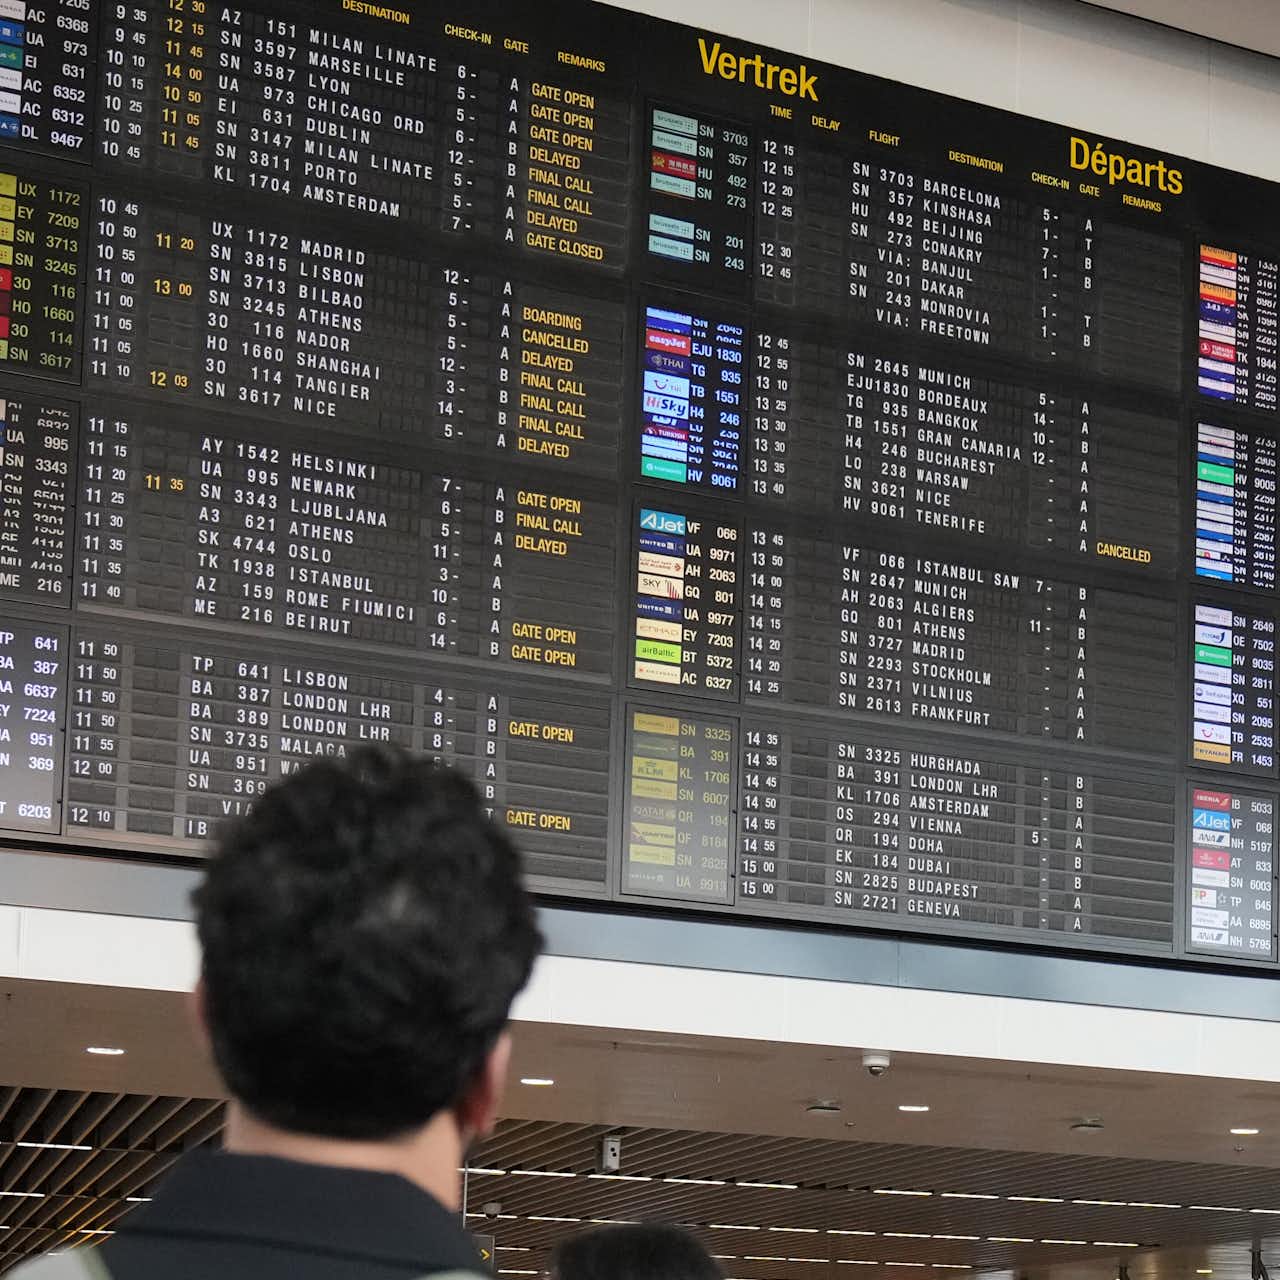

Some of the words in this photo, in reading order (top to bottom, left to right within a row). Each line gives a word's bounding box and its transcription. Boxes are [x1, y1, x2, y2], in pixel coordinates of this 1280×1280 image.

[342, 0, 410, 24] DESTINATION
[444, 24, 492, 44] CHECK-IN
[504, 38, 528, 54] GATE
[558, 52, 605, 72] REMARKS
[309, 51, 404, 86] MARSEILLE
[310, 29, 362, 54] MILAN
[376, 45, 436, 72] LINATE
[532, 83, 561, 101] GATE
[564, 90, 594, 109] OPEN
[698, 38, 819, 102] Vertrek
[309, 73, 350, 95] LYON
[308, 96, 381, 124] CHICAGO
[394, 116, 424, 134] ORD
[530, 146, 580, 169] DELAYED
[306, 118, 370, 144] DUBLIN
[529, 168, 562, 187] FINAL
[565, 176, 593, 194] CALL
[770, 104, 792, 120] TIME
[812, 115, 840, 131] DELAY
[869, 130, 900, 146] FLIGHT
[949, 150, 1003, 172] DESTINATION
[1032, 172, 1070, 190] CHECK-IN
[1079, 184, 1100, 197] GATE
[1122, 194, 1162, 212] REMARKS
[1070, 136, 1184, 195] Départs
[305, 162, 357, 186] PORTO
[924, 179, 1000, 209] BARCELONA
[303, 184, 399, 217] AMSTERDAM
[526, 232, 556, 250] GATE
[559, 239, 603, 260] CLOSED
[923, 199, 992, 226] KINSHASA
[923, 218, 982, 244] BEIJING
[301, 240, 365, 265] MADRID
[922, 238, 982, 263] CONAKRY
[922, 258, 973, 282] BANJUL
[300, 262, 364, 288] LISBON
[523, 307, 582, 330] BOARDING
[922, 278, 964, 299] DAKAR
[299, 284, 362, 309] BILBAO
[522, 329, 588, 353] CANCELLED
[921, 298, 990, 325] MONROVIA
[298, 307, 362, 332] ATHENS
[522, 350, 573, 372] DELAYED
[921, 318, 989, 344] FREETOWN
[297, 329, 349, 352] NADOR
[521, 372, 554, 390] FINAL
[557, 378, 586, 396] CALL
[297, 352, 379, 380] SHANGHAI
[662, 356, 684, 369] THAI
[296, 374, 369, 400] TANGIER
[918, 368, 970, 390] MUNICH
[294, 396, 336, 416] NICE
[918, 388, 987, 414] BORDEAUX
[918, 408, 978, 432] BANGKOK
[918, 428, 952, 447] GRAN
[962, 437, 1020, 460] CANARIA
[918, 448, 995, 475] BUCHAREST
[292, 453, 375, 480] HELSINKI
[518, 491, 547, 508] GATE
[550, 497, 580, 514] OPEN
[917, 468, 968, 490] WARSAW
[291, 476, 355, 499] NEWARK
[516, 513, 550, 531] FINAL
[553, 519, 582, 536] CALL
[291, 498, 387, 527] LJUBLJANA
[516, 535, 567, 555] DELAYED
[687, 521, 701, 534] VF
[716, 526, 737, 541] 066
[752, 531, 766, 546] 13
[772, 534, 784, 546] 45
[916, 509, 984, 533] TENERIFE
[1097, 542, 1151, 562] CANCELLED
[288, 544, 331, 563] OSLO
[686, 544, 701, 557] UA
[709, 548, 735, 563] 9971
[290, 566, 373, 592] ISTANBUL
[917, 560, 984, 583] ISTANBUL
[994, 573, 1019, 588] SAW
[685, 586, 700, 599] GQ
[715, 590, 734, 604] 801
[286, 589, 328, 608] ROME
[342, 598, 413, 620] FIUMICI
[512, 622, 542, 639] GATE
[545, 628, 576, 644] OPEN
[286, 612, 350, 634] BEIRUT
[914, 601, 974, 622] ALGIERS
[284, 668, 348, 690] LISBON
[912, 662, 991, 686] STOCKHOLM
[912, 682, 972, 703] VILNIUS
[284, 692, 347, 713] LONDON
[360, 702, 390, 718] LHR
[510, 721, 539, 738] GATE
[542, 726, 573, 742] OPEN
[912, 703, 990, 725] FRANKFURT
[911, 754, 980, 775] HURGHADA
[507, 810, 536, 826] GATE
[540, 814, 570, 830] OPEN
[910, 816, 962, 834] VIENNA
[909, 836, 943, 853] DOHA
[908, 858, 950, 874] DUBAI
[908, 878, 978, 898] BUDAPEST
[908, 899, 960, 916] GENEVA
